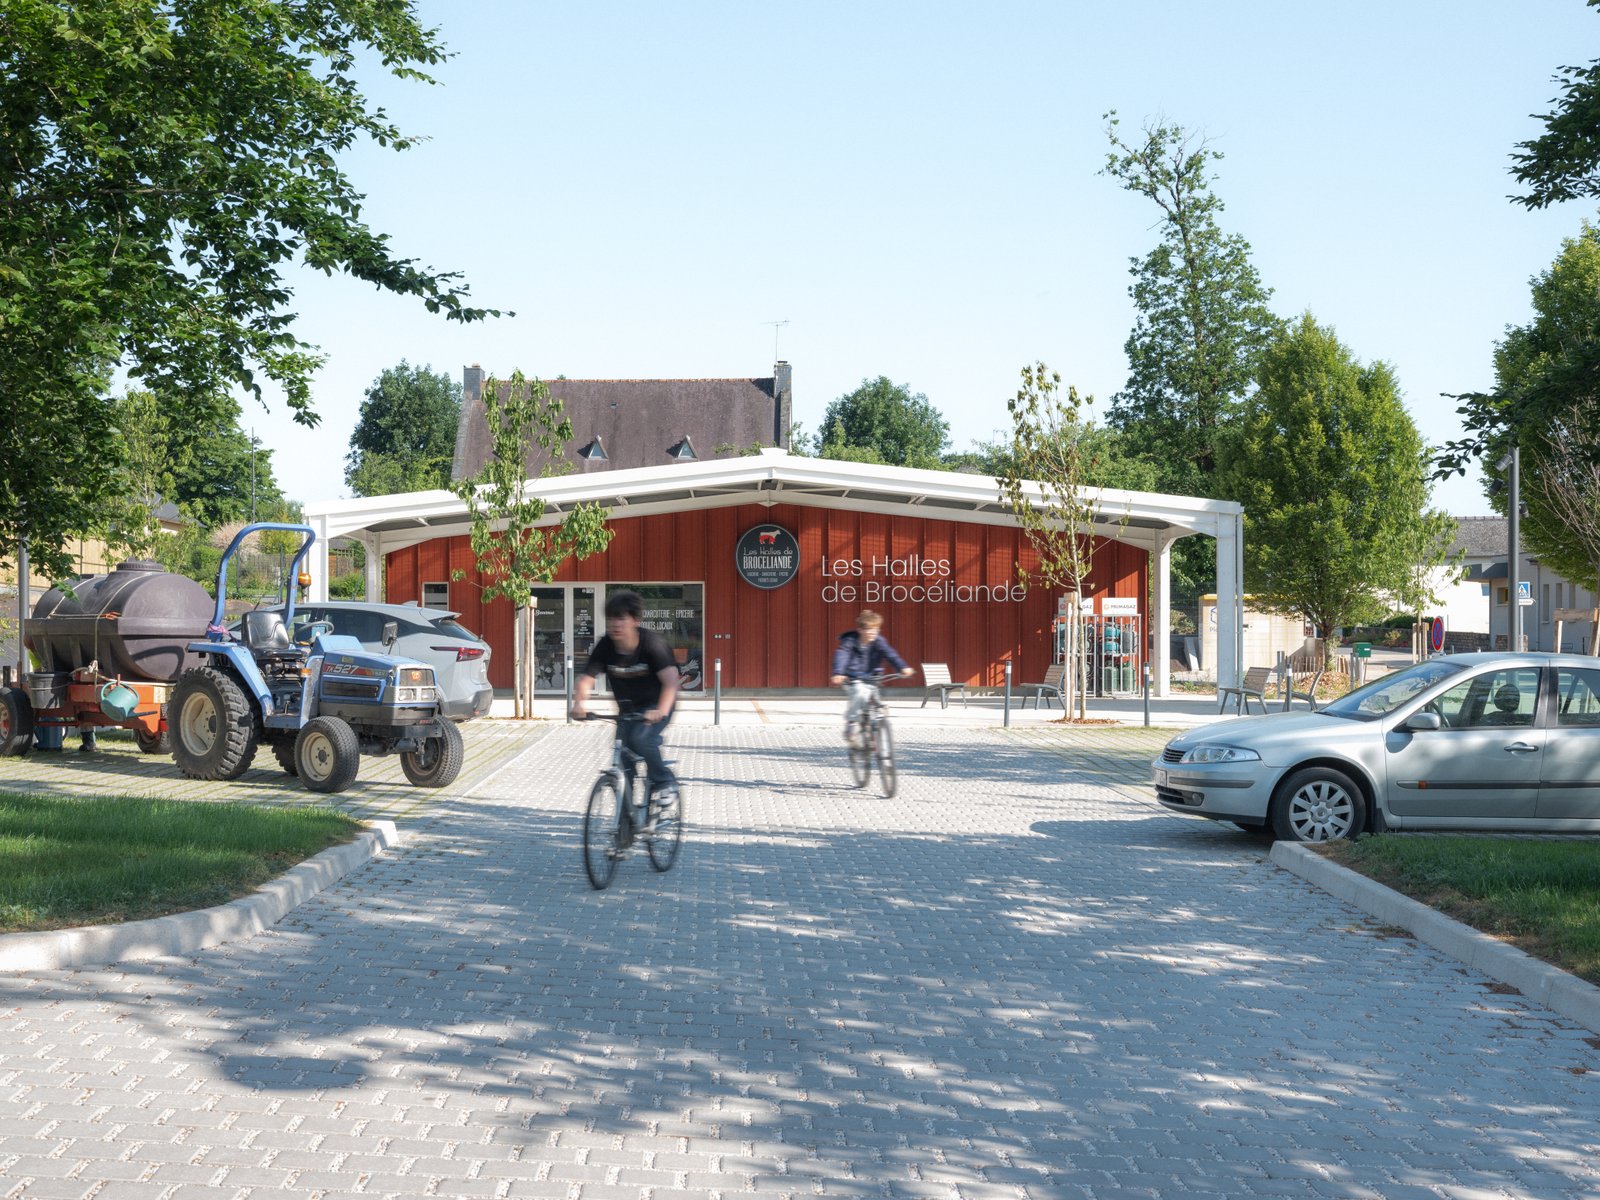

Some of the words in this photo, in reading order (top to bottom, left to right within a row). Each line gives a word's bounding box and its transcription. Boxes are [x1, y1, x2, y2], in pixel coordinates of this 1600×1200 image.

[783, 546, 793, 555] de
[743, 555, 793, 569] BROCELIANDE
[821, 555, 863, 577] Les
[872, 554, 951, 577] Halles
[821, 581, 857, 603] de
[866, 579, 1027, 603] Brocéliande
